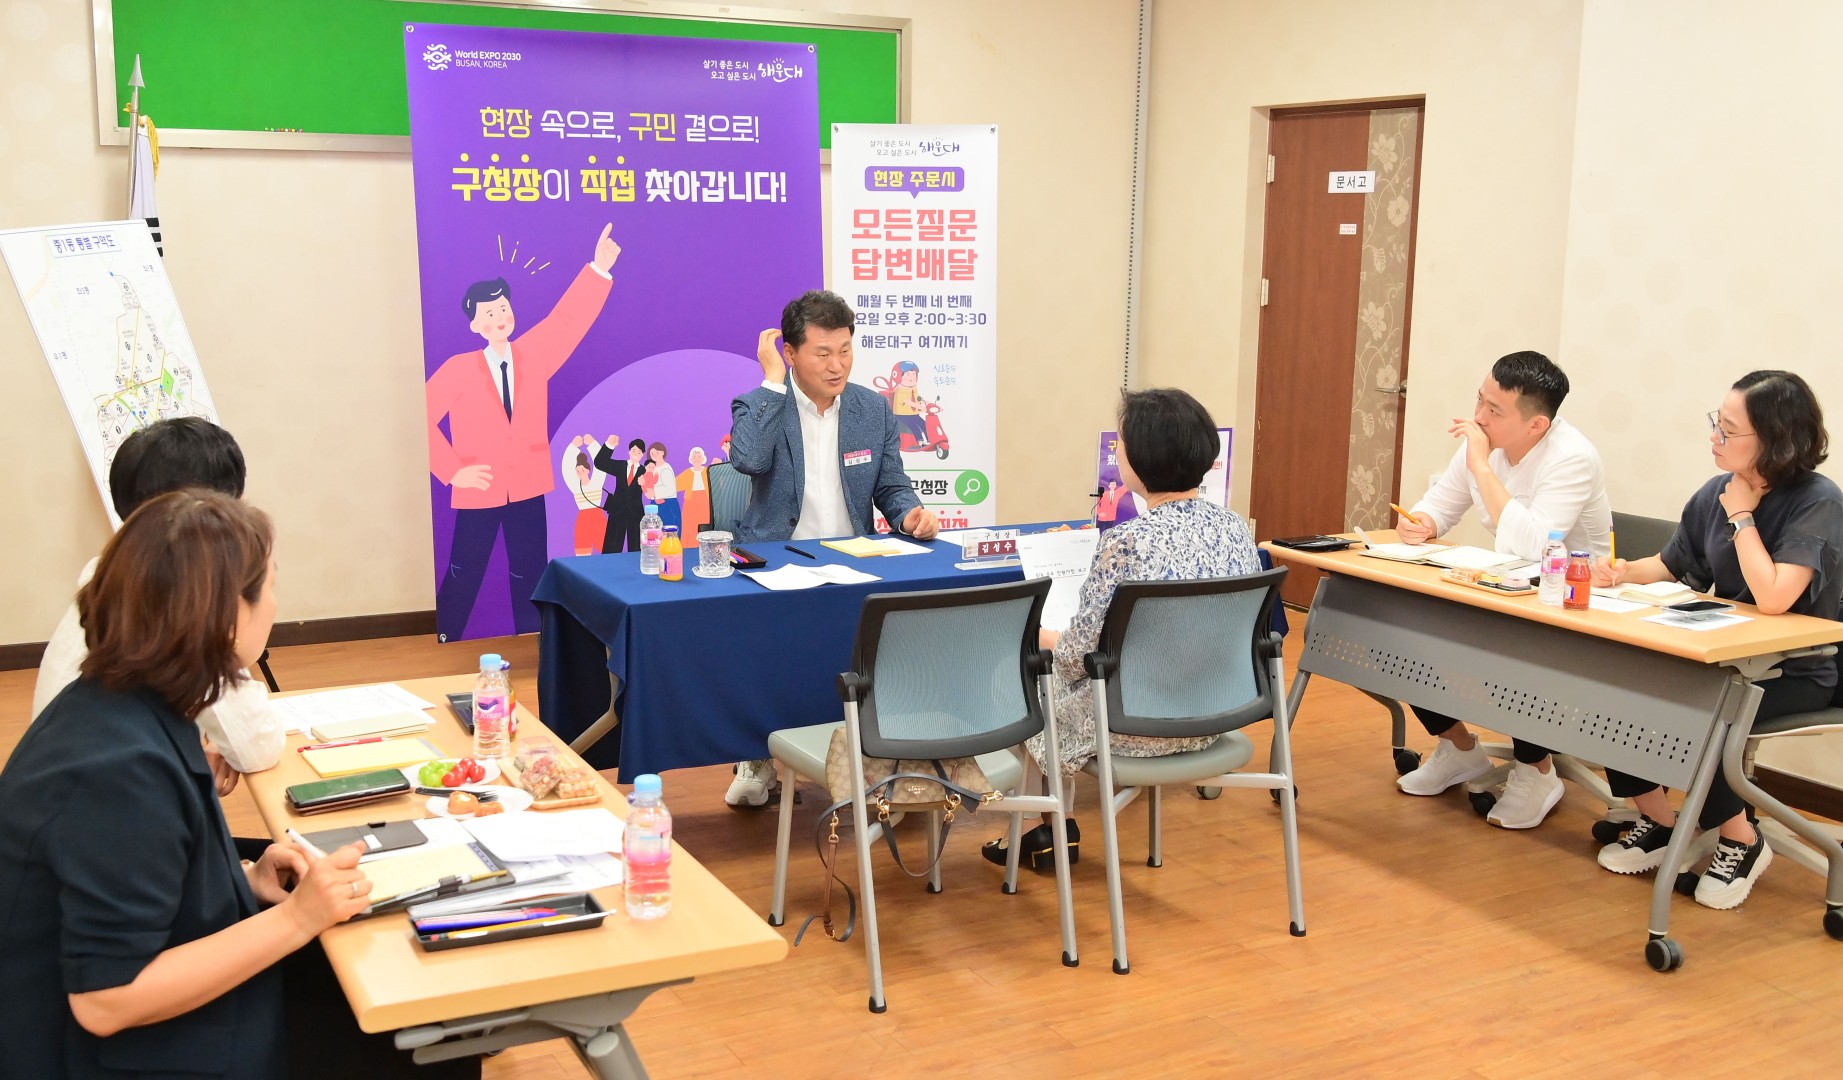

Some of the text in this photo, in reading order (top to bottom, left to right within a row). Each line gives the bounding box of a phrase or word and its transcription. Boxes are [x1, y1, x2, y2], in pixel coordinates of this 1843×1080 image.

[455, 50, 521, 61] World EXPO 2030
[455, 60, 508, 69] BUSAN, KOREA
[703, 60, 749, 70] 살기 좋은 도시
[710, 71, 757, 81] 오고 싶은 도시
[480, 106, 760, 144] 현장 속으로, 구민 곁으로!
[904, 149, 917, 157] 도시
[451, 165, 787, 203] 구청장이 직접 찾아갑니다!
[873, 169, 956, 188] 현장 주문시
[1336, 175, 1367, 189] 문서고
[851, 209, 977, 242] 모든질문
[92, 234, 116, 249] 구역도
[851, 248, 978, 281] 답변배달
[857, 294, 972, 309] 매월 두 번째 네 번째
[854, 311, 987, 326] 요일 오후 2:00~3:30
[861, 335, 968, 349] 해운대구 여기저기
[982, 541, 1012, 554] 김성수
